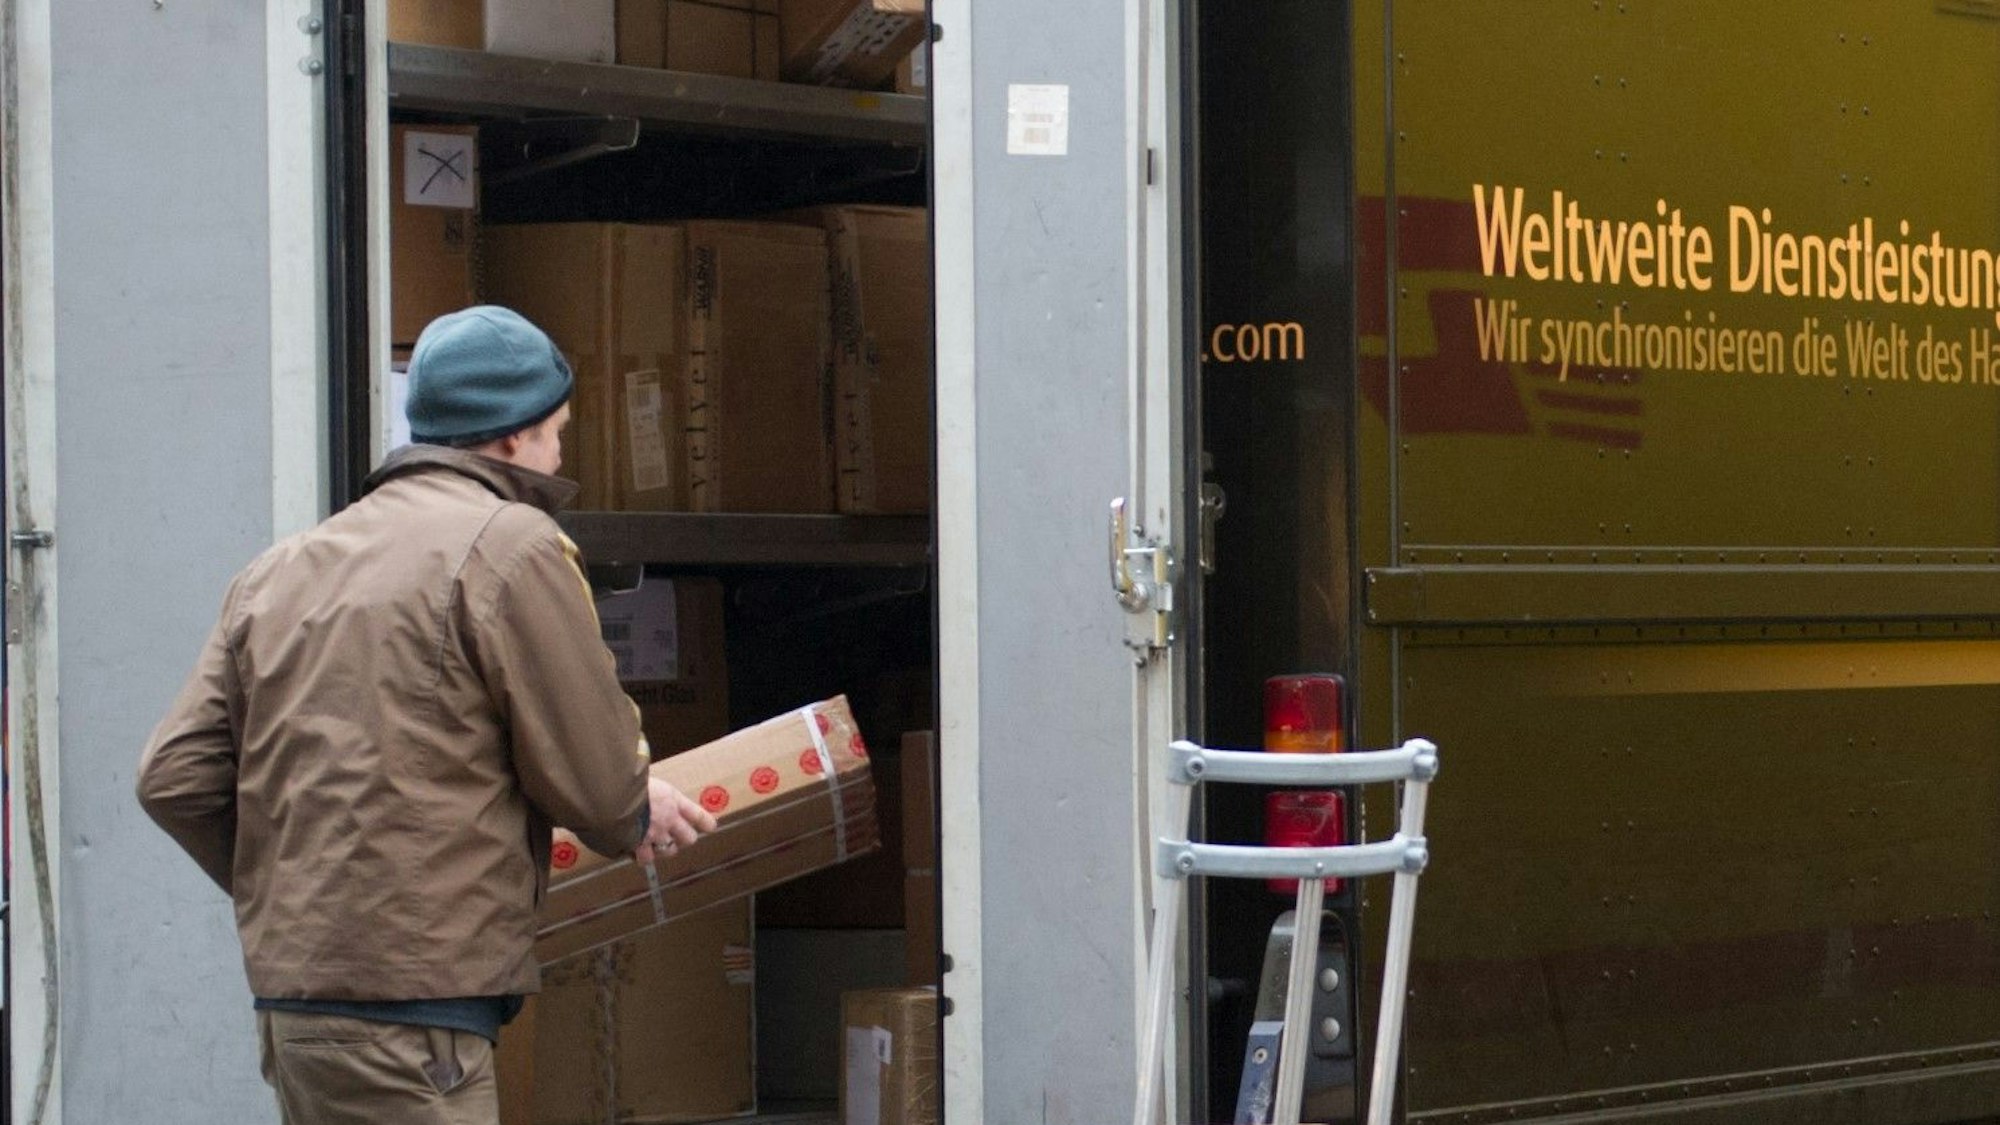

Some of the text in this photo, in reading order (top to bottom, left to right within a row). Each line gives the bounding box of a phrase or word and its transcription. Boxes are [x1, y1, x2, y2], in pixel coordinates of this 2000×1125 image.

[1472, 183, 2000, 331] Weltweite Dienstleistun
[1201, 321, 1306, 362] .com
[1474, 298, 1532, 363] Wir
[1541, 306, 1784, 382] synchronisieren
[1793, 317, 1837, 377] die
[1845, 320, 1909, 380] Welt
[1916, 325, 1963, 384] des
